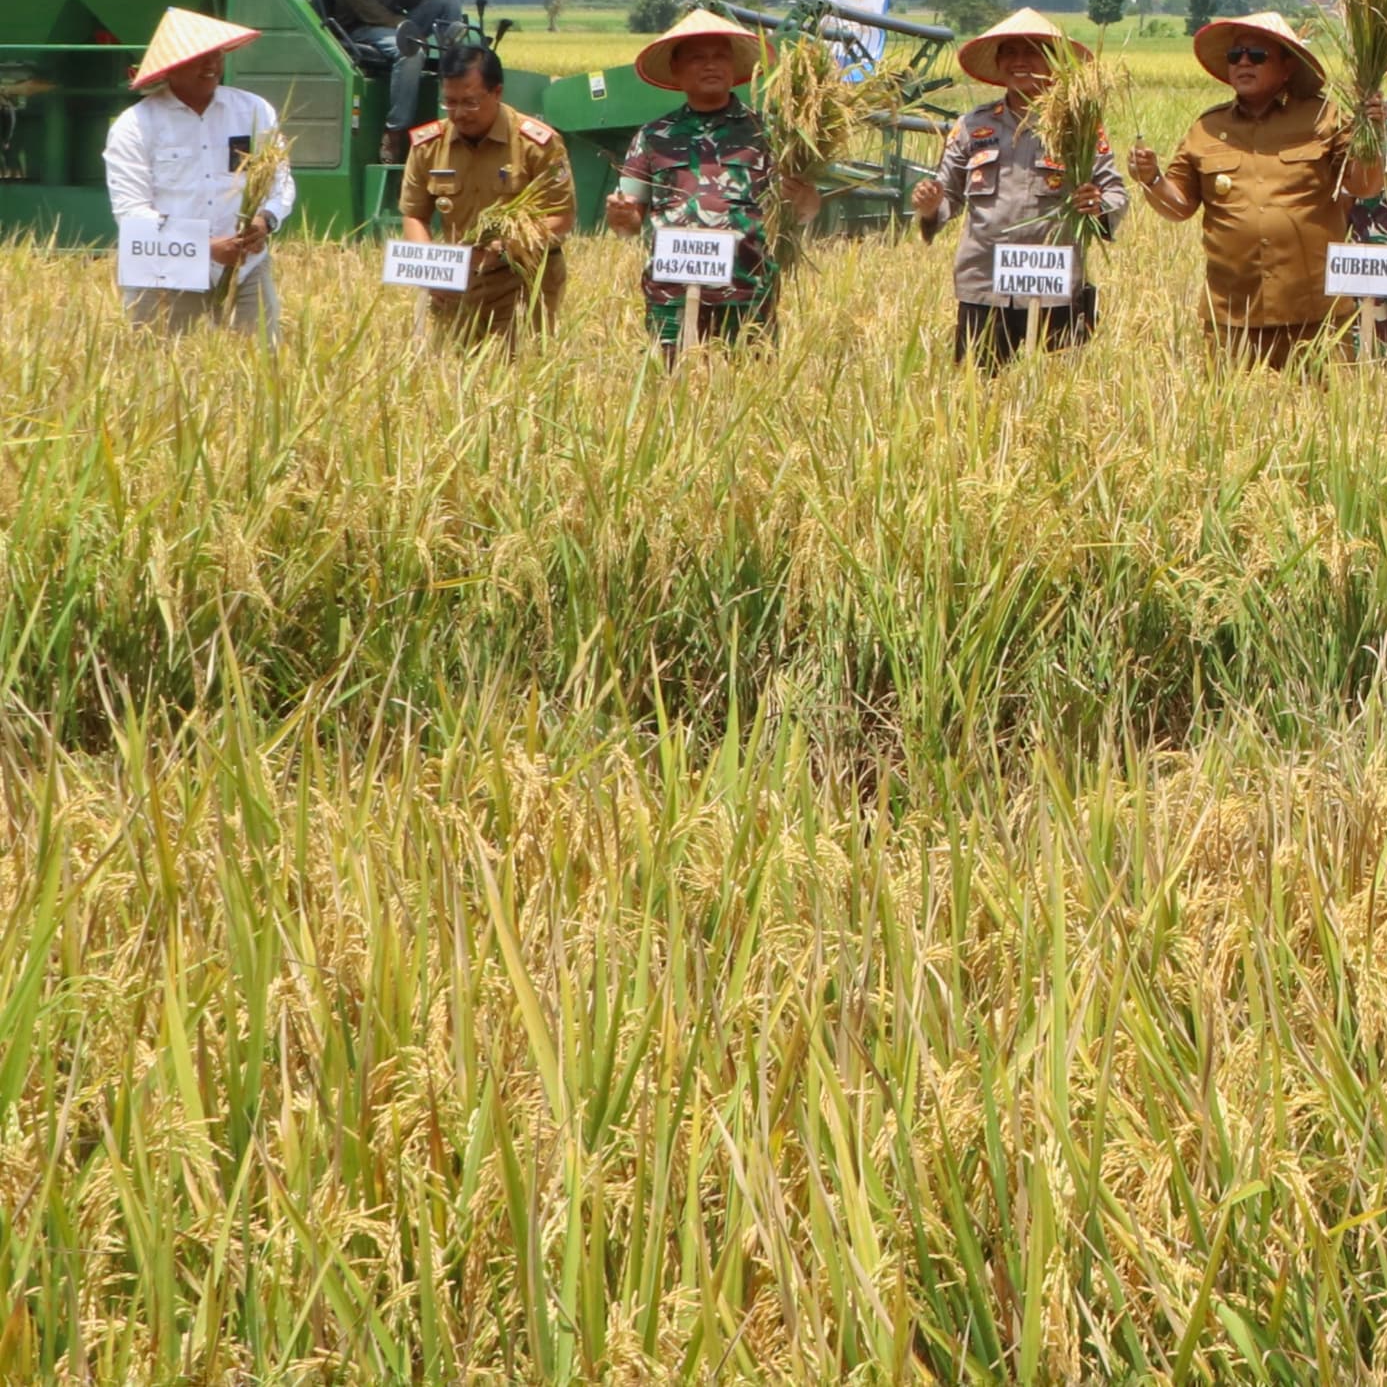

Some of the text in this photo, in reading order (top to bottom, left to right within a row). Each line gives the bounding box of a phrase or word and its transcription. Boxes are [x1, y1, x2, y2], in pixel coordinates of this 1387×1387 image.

[131, 240, 197, 257] BULOG
[392, 245, 465, 264] KADIS KPTPH
[672, 239, 720, 256] DANREM
[656, 258, 726, 276] 043/GATAM
[1001, 250, 1065, 270] KAPOLDA
[396, 263, 454, 282] PROVINSI
[1000, 274, 1064, 294] LAMPUNG
